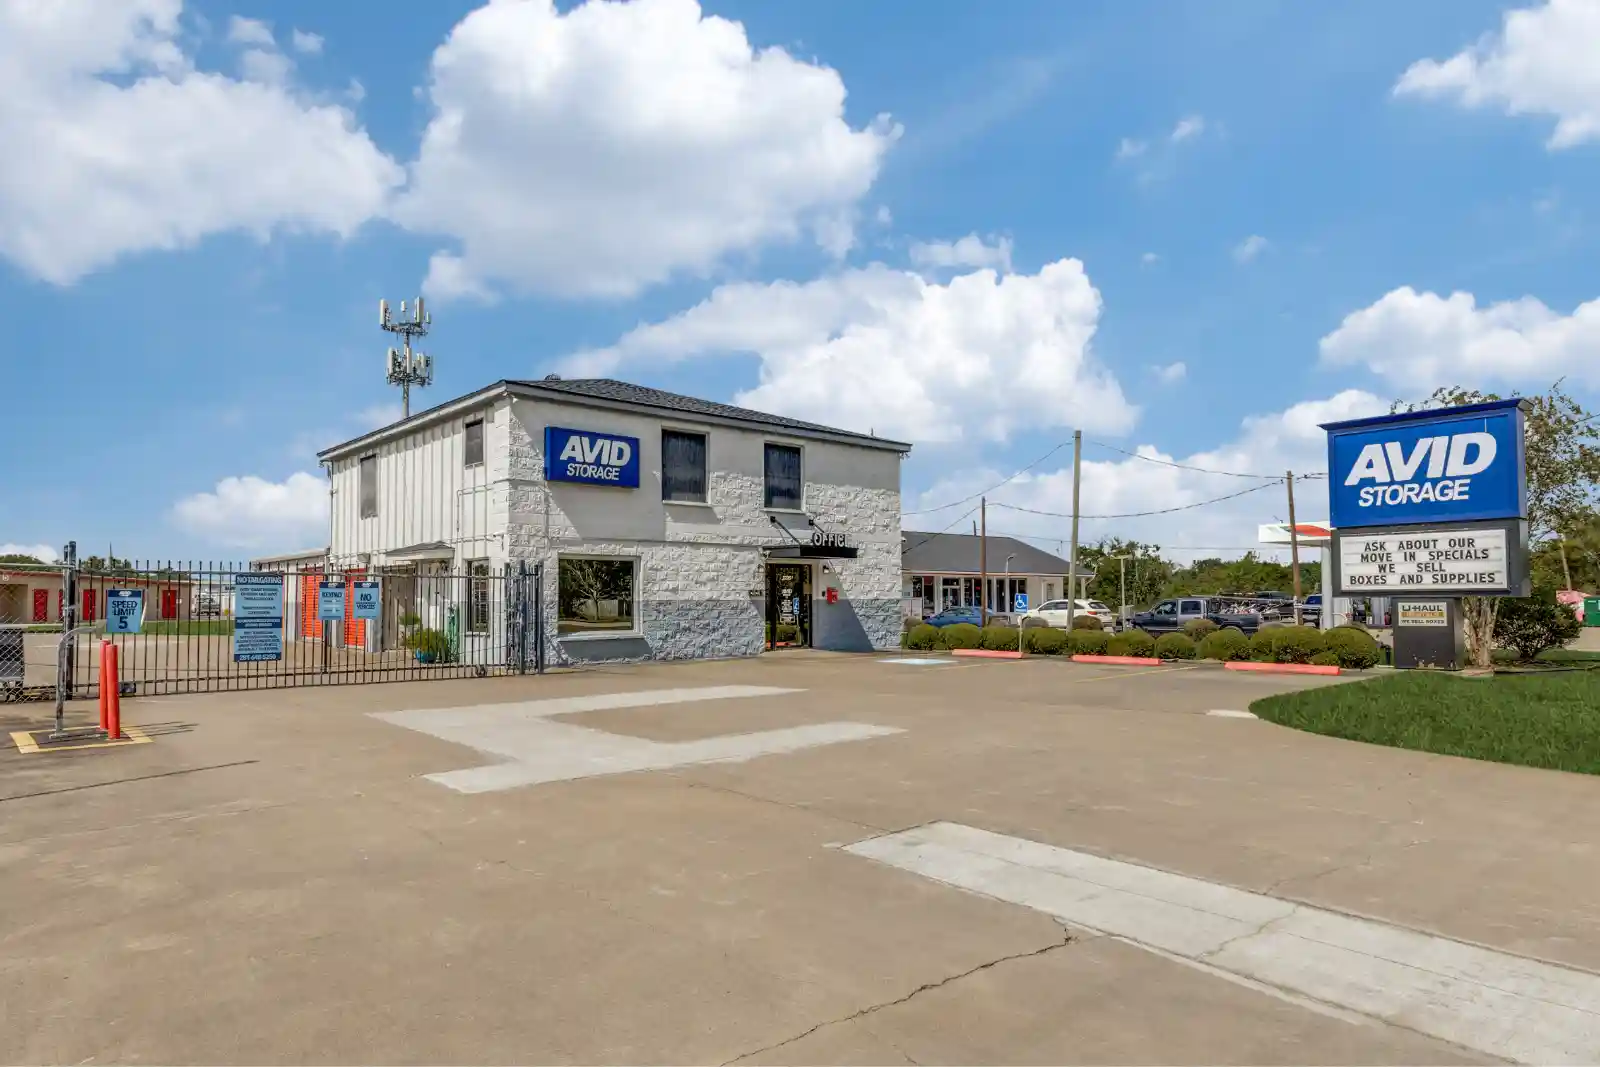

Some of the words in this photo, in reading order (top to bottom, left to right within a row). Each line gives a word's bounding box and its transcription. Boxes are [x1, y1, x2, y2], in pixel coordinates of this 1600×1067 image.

[560, 435, 631, 467] AVID
[1344, 432, 1497, 486] AVID
[566, 463, 620, 480] STORAGE
[1358, 479, 1471, 507] STORAGE
[1364, 542, 1387, 552] ASK
[1398, 539, 1439, 550] ABOUT
[1448, 538, 1476, 548] OUR
[1360, 553, 1392, 563] MOVE
[1403, 551, 1416, 562] IN
[1428, 549, 1489, 560] SPECIALS
[1378, 563, 1396, 573] WE
[1416, 562, 1446, 573] SELL
[237, 576, 248, 584] NO
[248, 576, 282, 584] TAILGATING
[1350, 575, 1387, 585] BOXES
[1399, 574, 1423, 584] AND
[1432, 572, 1495, 584] SUPPLIES
[360, 593, 372, 601] NO
[112, 600, 138, 608] SPEED
[113, 608, 136, 616] LIMIT
[118, 616, 128, 629] 5
